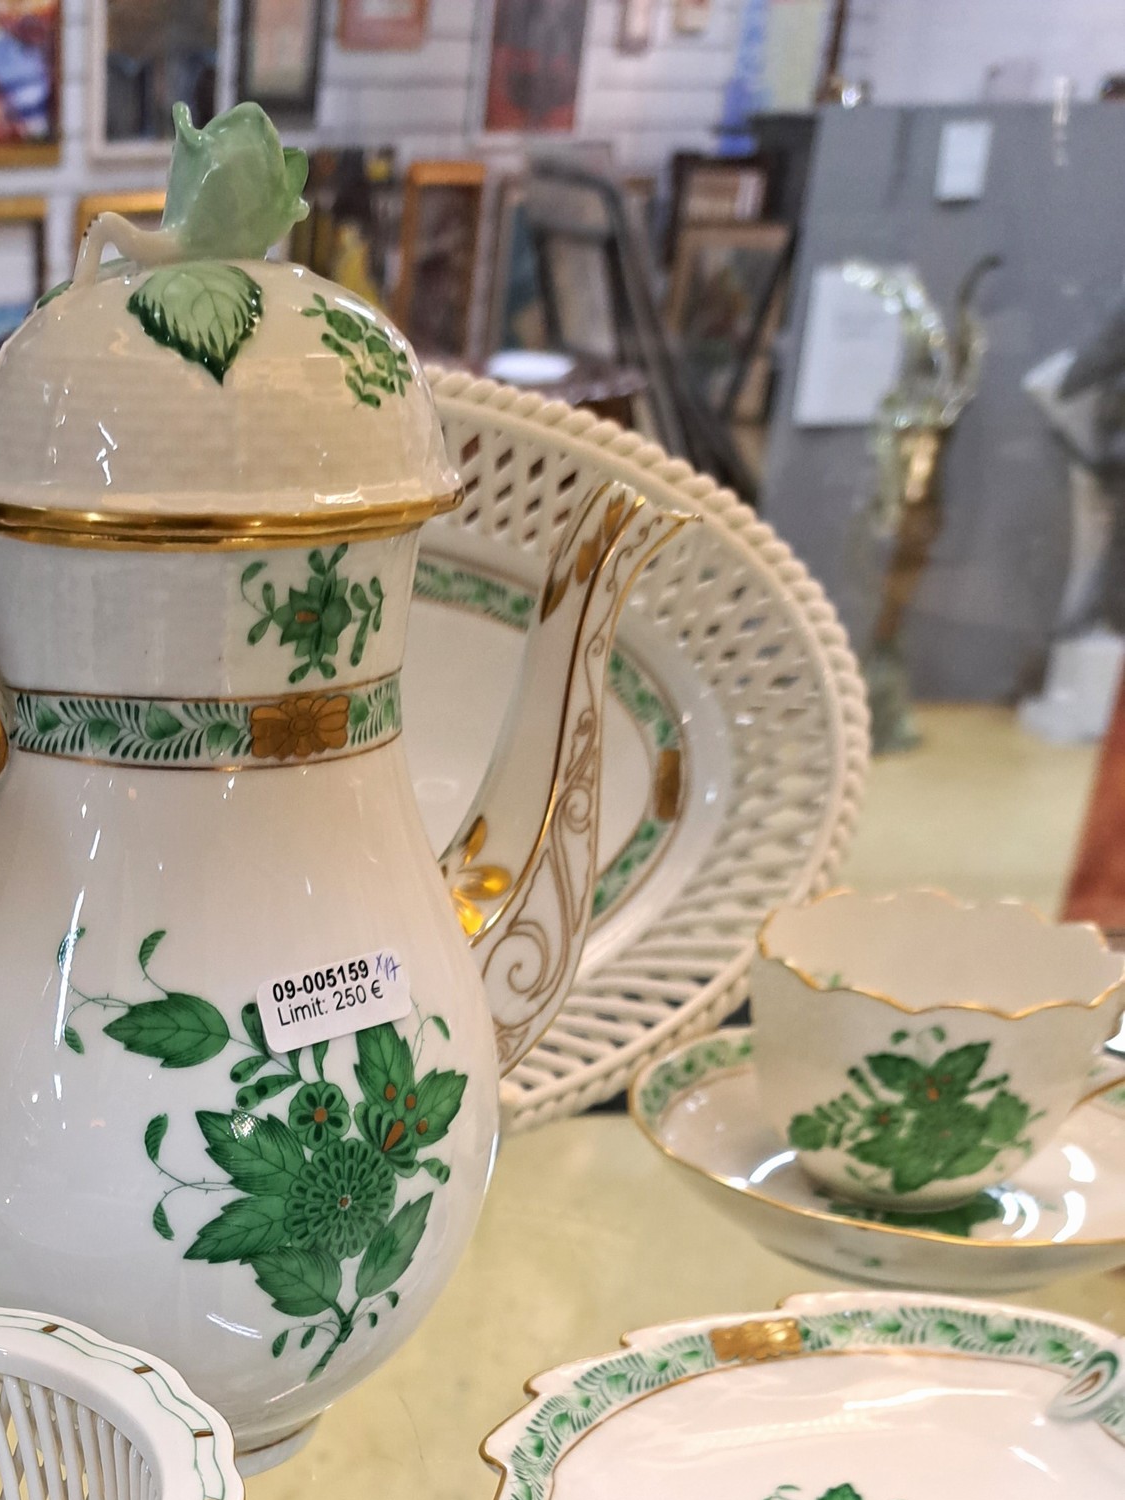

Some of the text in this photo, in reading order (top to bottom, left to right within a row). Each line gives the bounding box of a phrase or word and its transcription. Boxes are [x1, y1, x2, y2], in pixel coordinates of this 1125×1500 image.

[272, 959, 369, 1002] 09-005159
[277, 979, 384, 1026] Limit: 250 €
